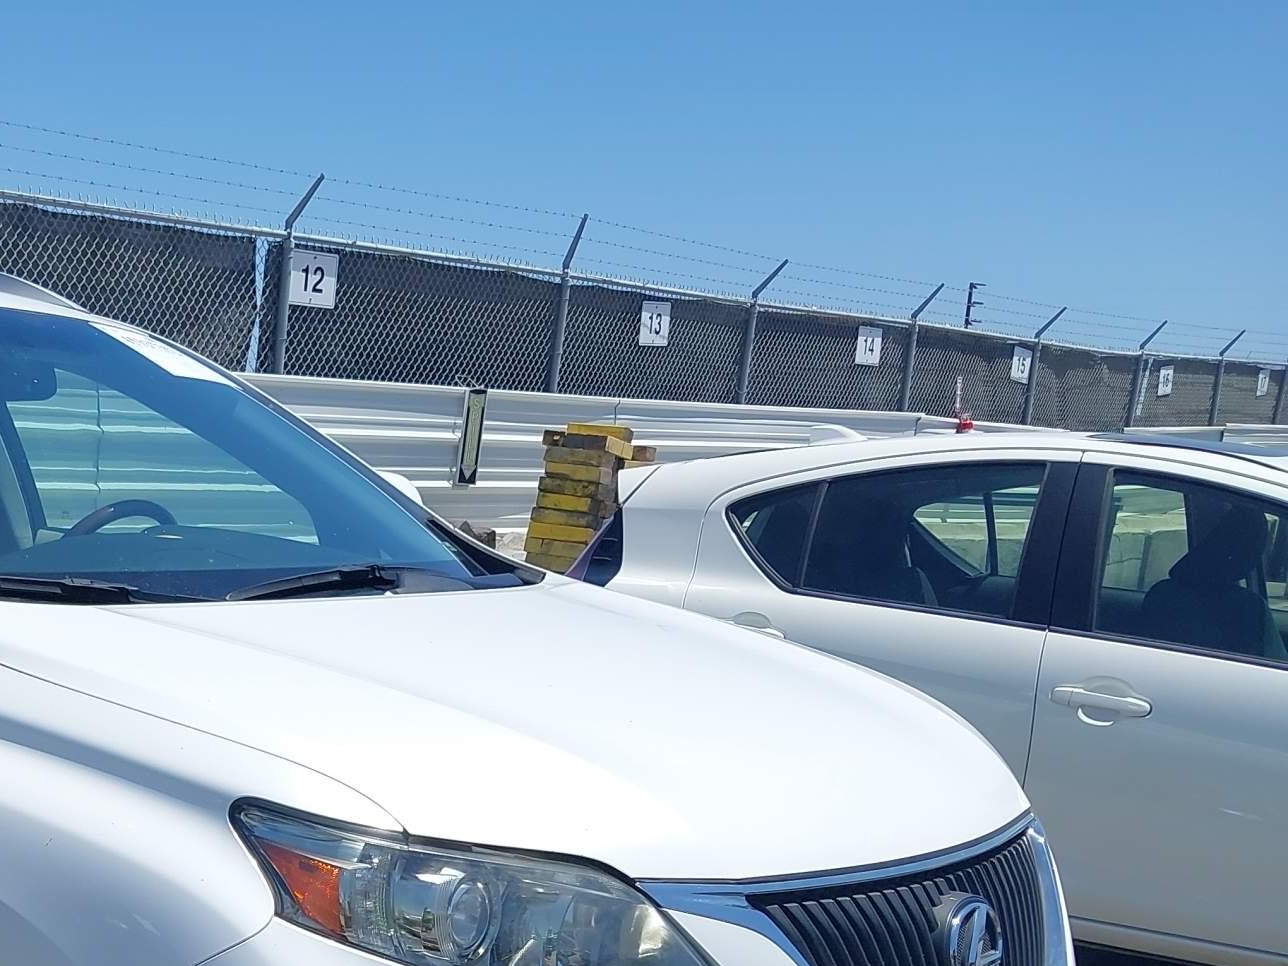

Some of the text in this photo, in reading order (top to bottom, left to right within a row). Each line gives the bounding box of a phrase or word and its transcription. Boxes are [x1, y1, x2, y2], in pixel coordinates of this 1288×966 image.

[302, 264, 325, 294] 12
[648, 312, 662, 335] 13
[864, 336, 875, 356] 14
[1017, 356, 1026, 374] 15
